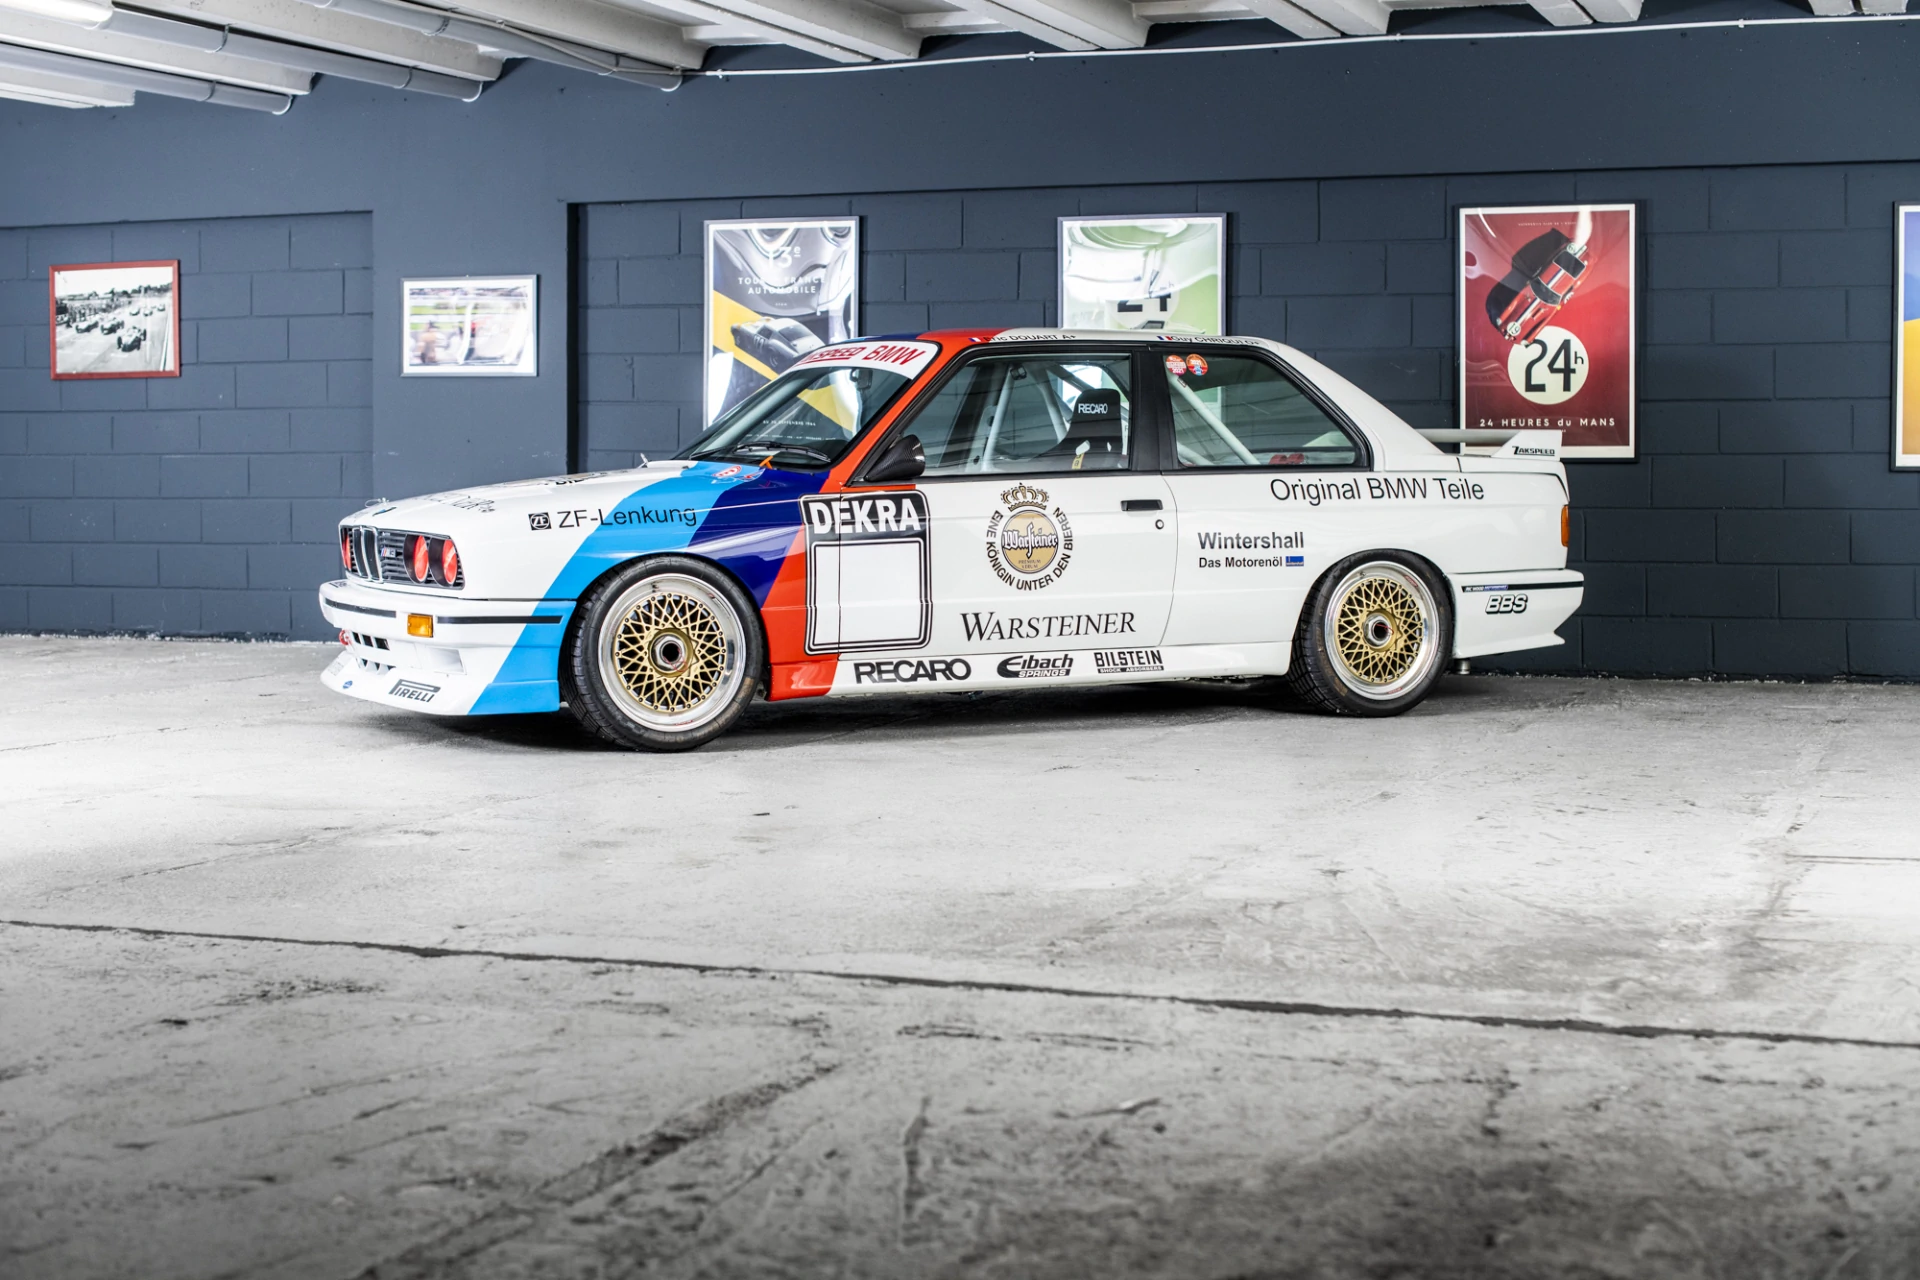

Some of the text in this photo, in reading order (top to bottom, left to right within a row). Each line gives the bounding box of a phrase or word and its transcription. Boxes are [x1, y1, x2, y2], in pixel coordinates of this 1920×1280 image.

[747, 285, 817, 295] AUTOMOBILE
[862, 345, 926, 365] BMW
[1078, 403, 1108, 414] RECARO
[1479, 417, 1616, 427] 24 HEURES du MANS
[1511, 446, 1555, 456] ZAKSPEED
[1270, 478, 1485, 506] Original BMW Teile
[557, 506, 697, 527] ZF-Lenkung
[808, 498, 922, 535] DEKRA
[986, 507, 1073, 591] EINE KÖNIGIN UNTER DEN BIEREN
[1198, 532, 1305, 550] Wintershall
[1199, 556, 1221, 568] Das
[1225, 556, 1283, 568] Motorenöl
[1485, 594, 1528, 614] BBS
[959, 611, 1136, 642] WARSTEINER
[997, 654, 1074, 676] Eibach
[1094, 650, 1163, 667] BILSTEIN
[853, 658, 972, 684] RECARO
[1017, 668, 1068, 678] SPRINGS
[388, 679, 441, 702] PIRELLI
